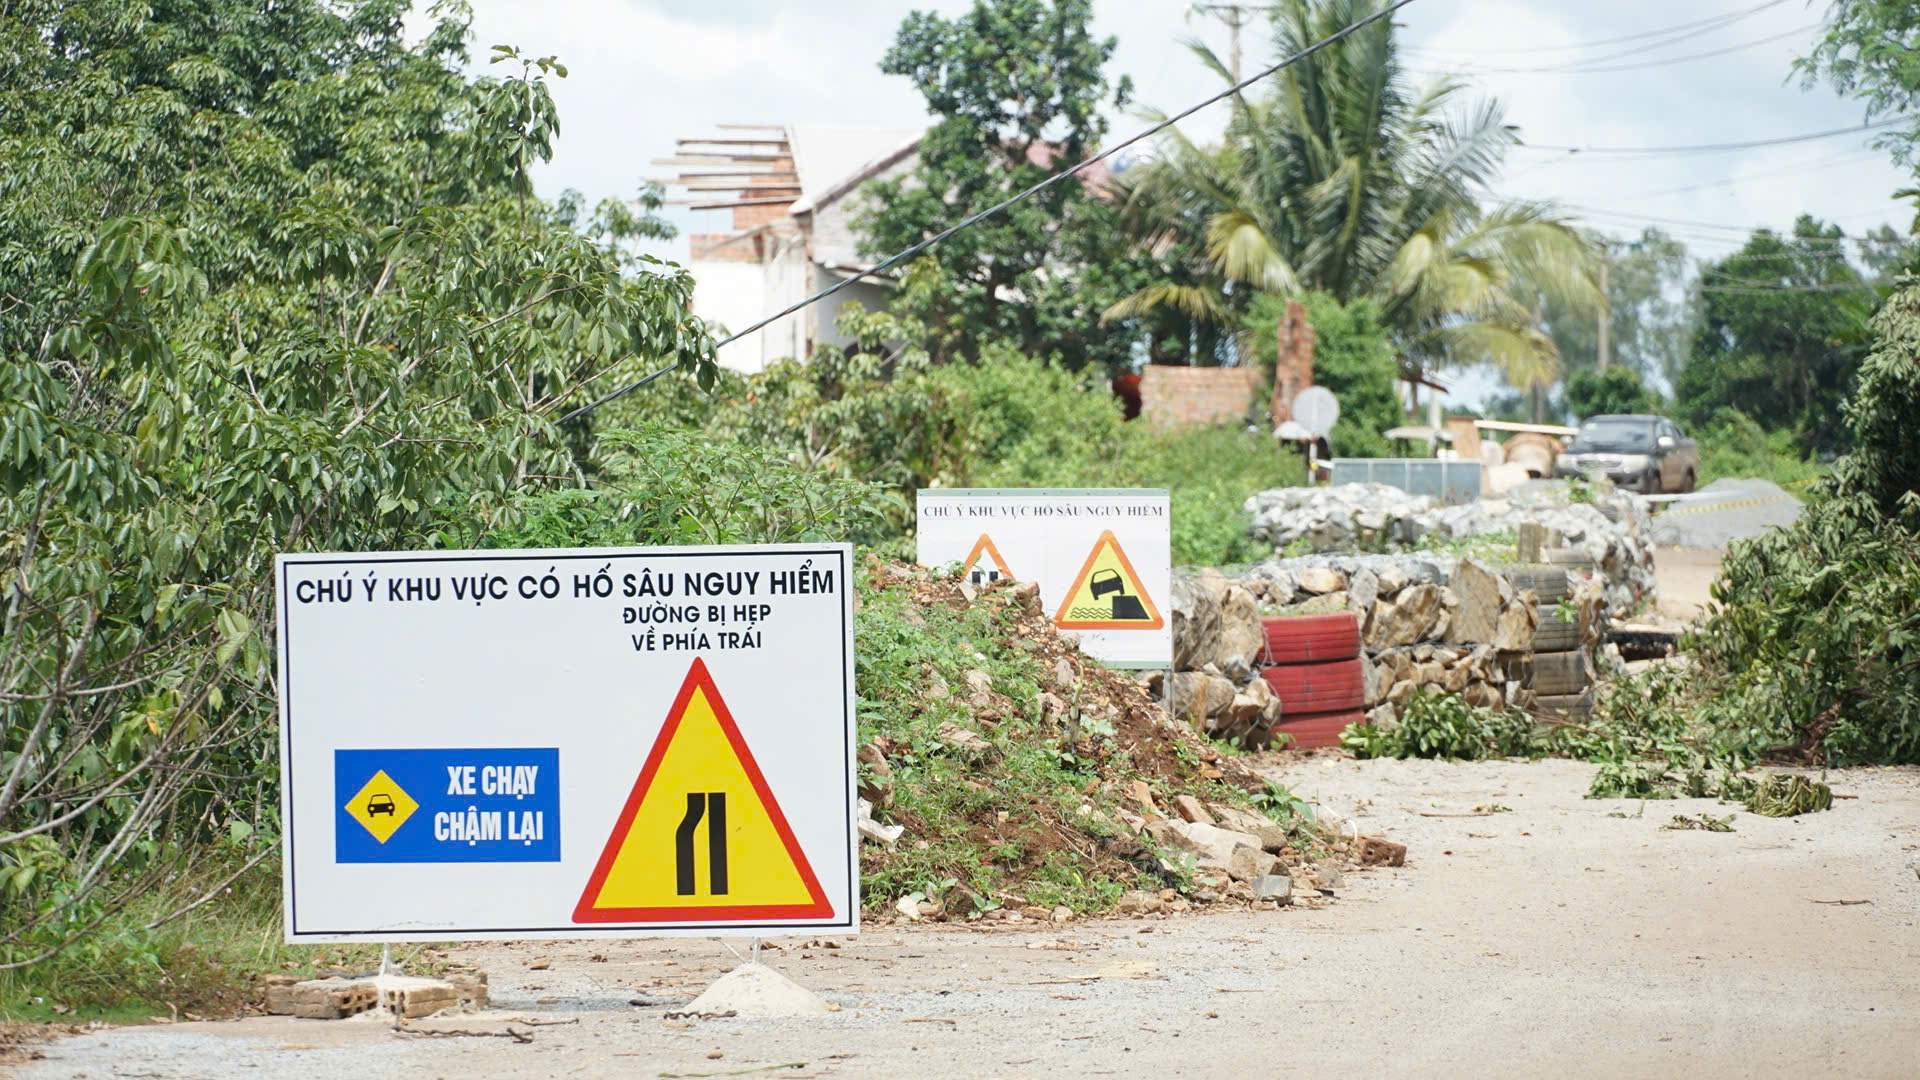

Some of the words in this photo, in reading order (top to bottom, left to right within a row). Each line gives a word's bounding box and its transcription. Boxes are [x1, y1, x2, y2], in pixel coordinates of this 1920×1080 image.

[923, 503, 952, 518] CHÚ
[968, 505, 997, 518] KHU
[1056, 503, 1082, 517] SÂU
[1085, 505, 1123, 517] NGUY
[296, 570, 352, 604] CHÚ
[362, 570, 378, 602] Ý
[388, 577, 441, 602] KHU
[450, 572, 508, 607] VỰC
[517, 565, 560, 600] CÓ
[573, 562, 614, 598] HỐ
[622, 567, 674, 598] SÂU
[684, 571, 760, 597] NGUY
[770, 558, 834, 595] HIỂM
[622, 600, 701, 624] ĐƯỜNG
[707, 604, 726, 626] BỊ
[733, 604, 771, 626] HẸP
[631, 625, 656, 652] VỀ
[662, 627, 711, 651] PHÍA
[717, 626, 761, 650] TRÁI
[447, 765, 477, 796] XE
[481, 765, 539, 801] CHẠY
[434, 805, 502, 847] CHẬM
[507, 810, 544, 846] LẠI
